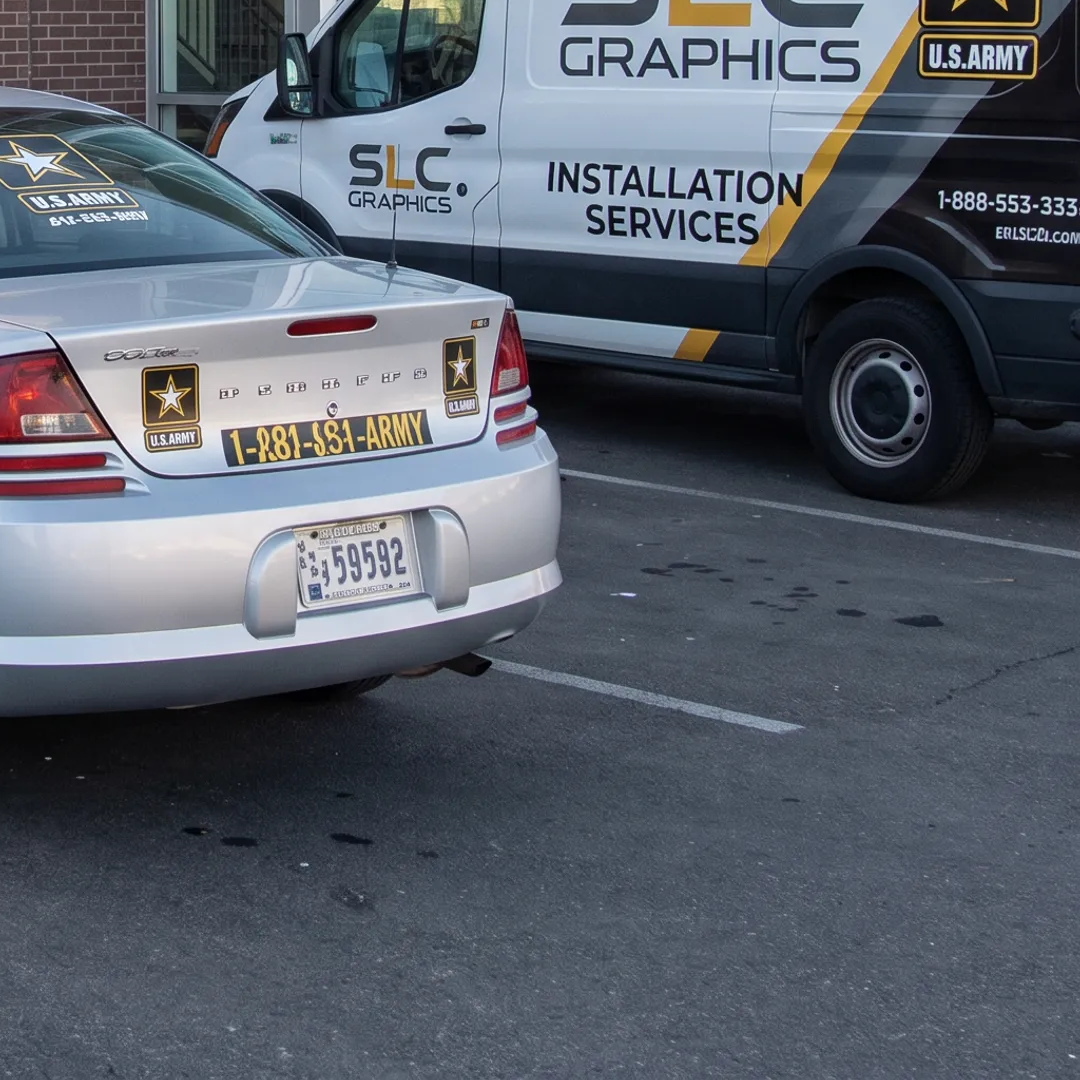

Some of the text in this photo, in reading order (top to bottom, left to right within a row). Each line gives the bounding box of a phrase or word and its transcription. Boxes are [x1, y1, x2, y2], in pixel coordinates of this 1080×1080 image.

[559, 36, 861, 83] GRAPHICS
[928, 43, 1029, 72] U.S.ARMY
[349, 144, 452, 192] SLC
[547, 162, 804, 207] INSTALLATION
[29, 191, 125, 209] U.S.ARMY
[348, 191, 452, 214] GRAPHICS
[937, 190, 1080, 217] 1-888-553-333
[586, 204, 760, 245] SERVICES
[150, 431, 196, 447] U.S.ARMY
